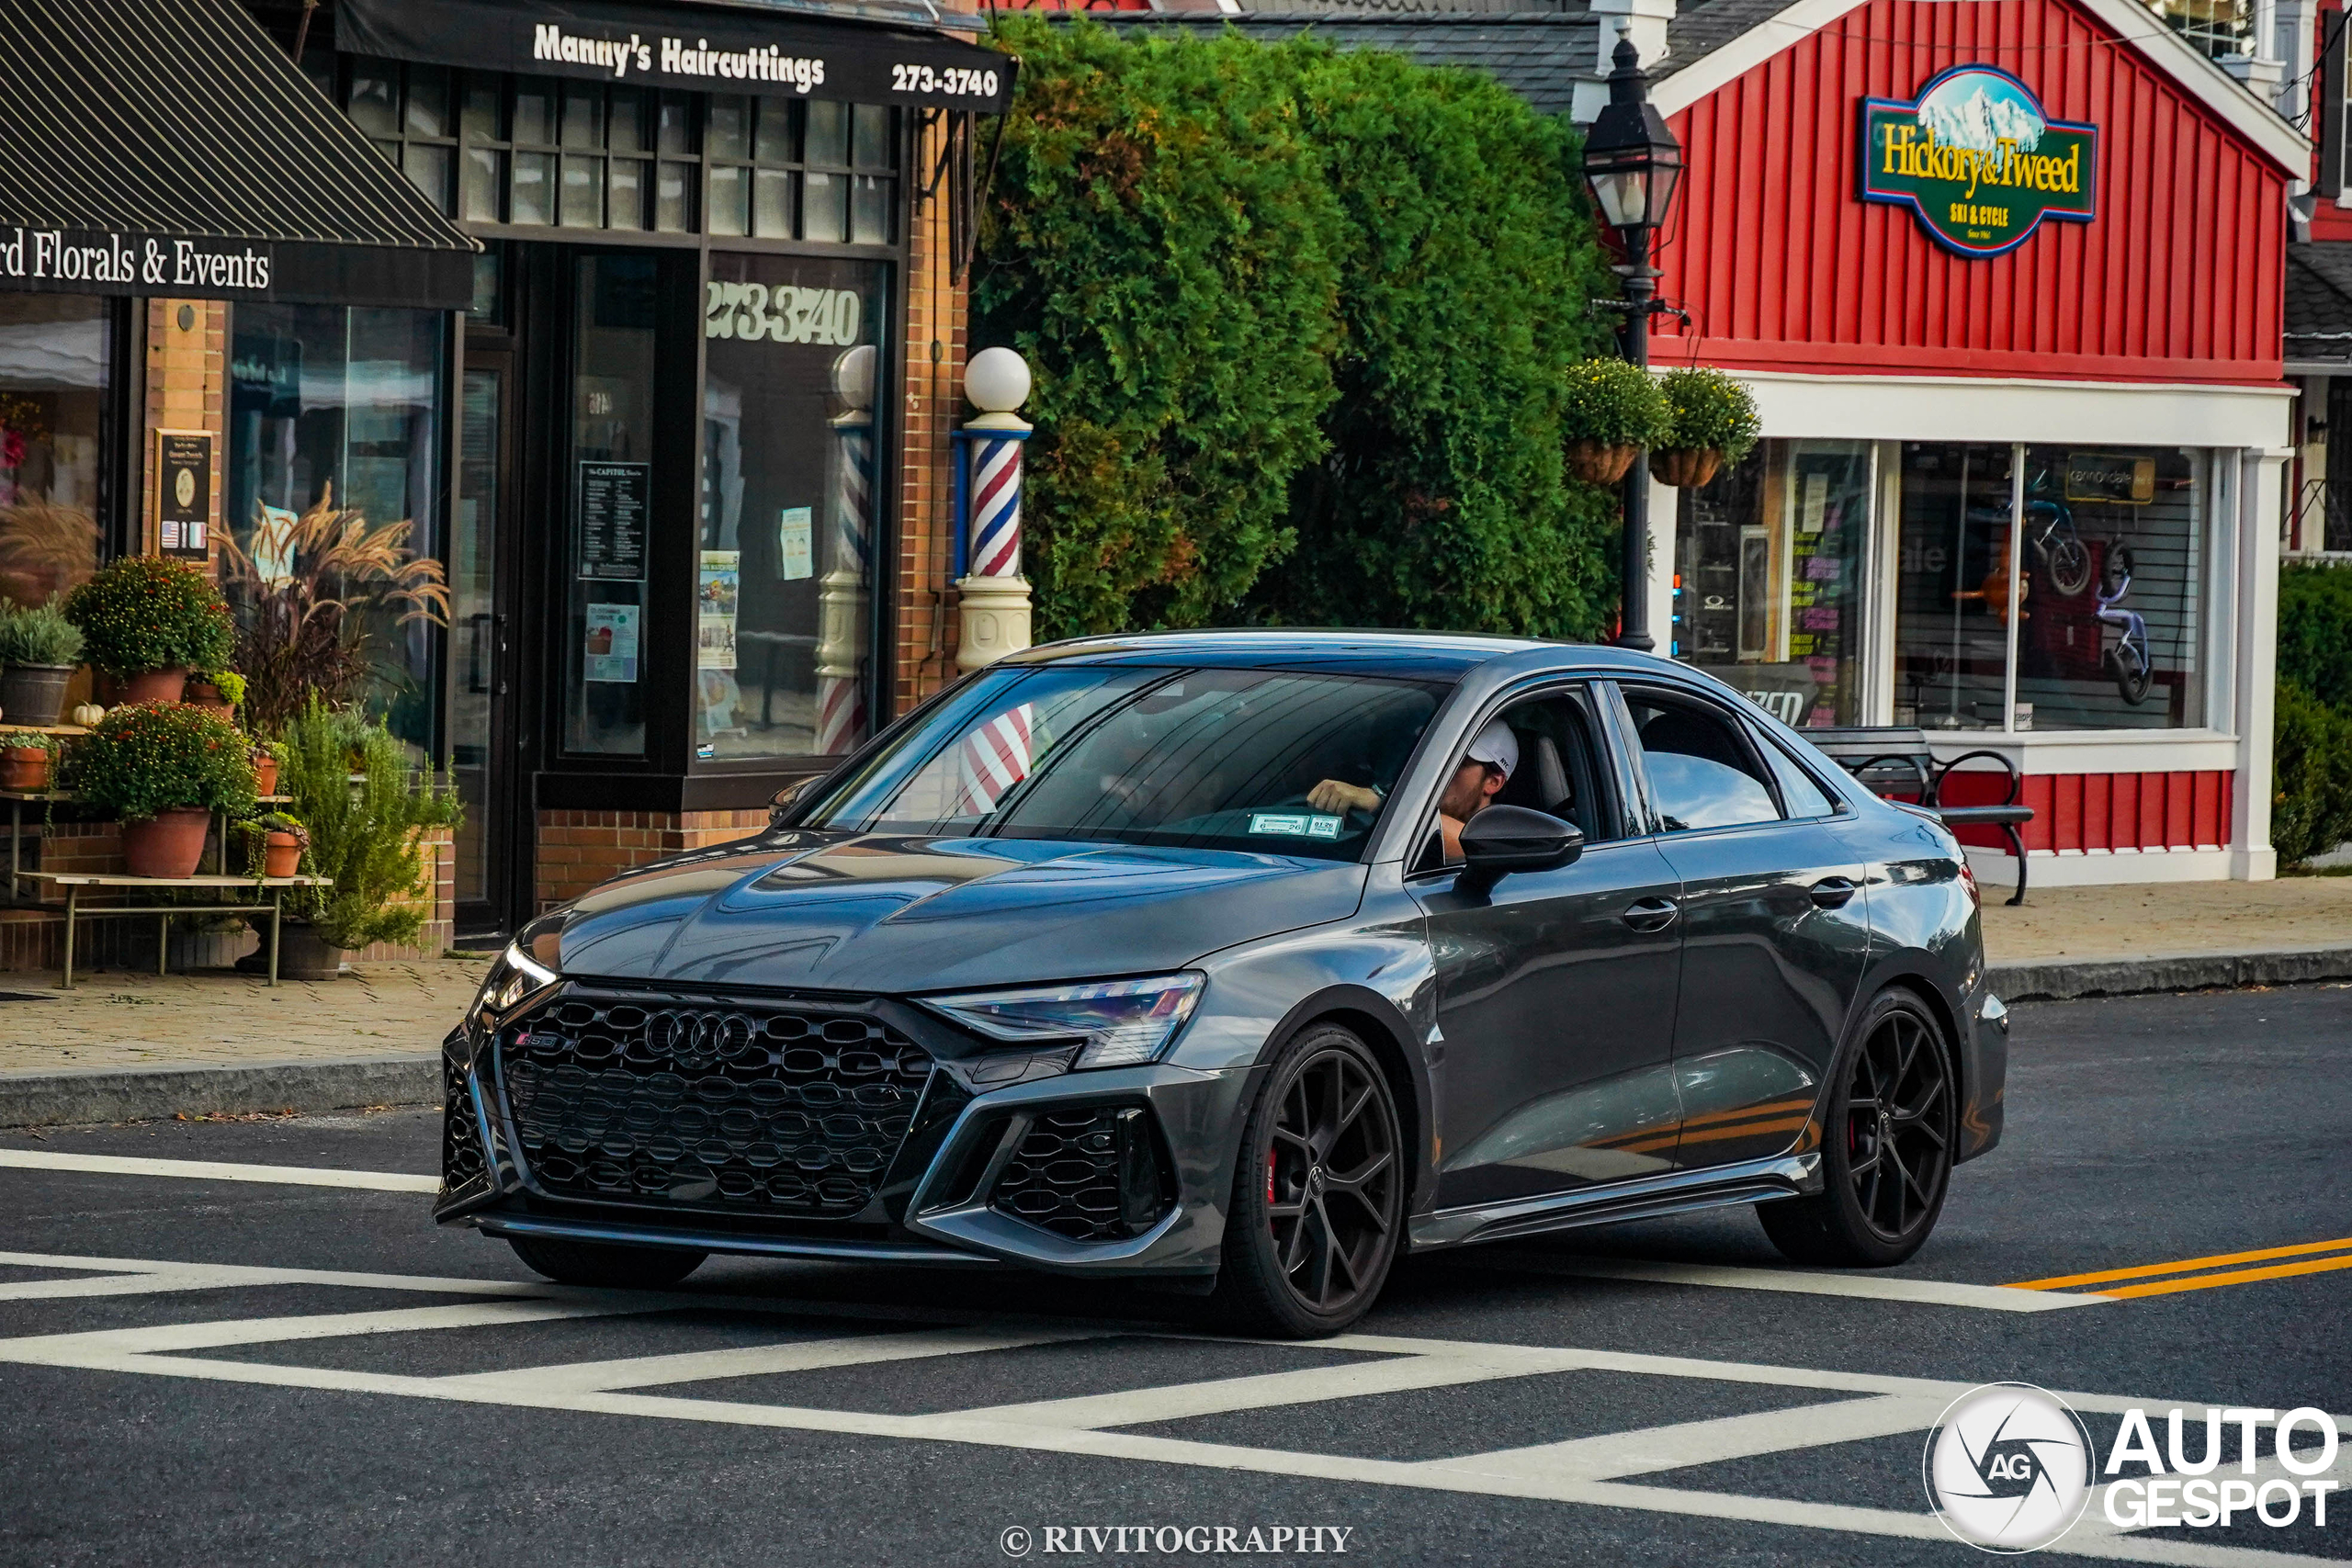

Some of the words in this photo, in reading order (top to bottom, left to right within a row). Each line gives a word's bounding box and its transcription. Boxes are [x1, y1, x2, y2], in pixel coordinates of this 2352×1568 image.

[533, 23, 652, 78] Manny's
[660, 37, 825, 94] Haircuttings
[891, 63, 1000, 97] 273-3740
[1951, 202, 1967, 223] SKI
[1969, 204, 1978, 225] &
[1979, 205, 2008, 228] CYCLE
[33, 231, 135, 283] Florals
[141, 237, 167, 285] &
[173, 239, 269, 289] Events
[1499, 757, 1510, 770] NYC
